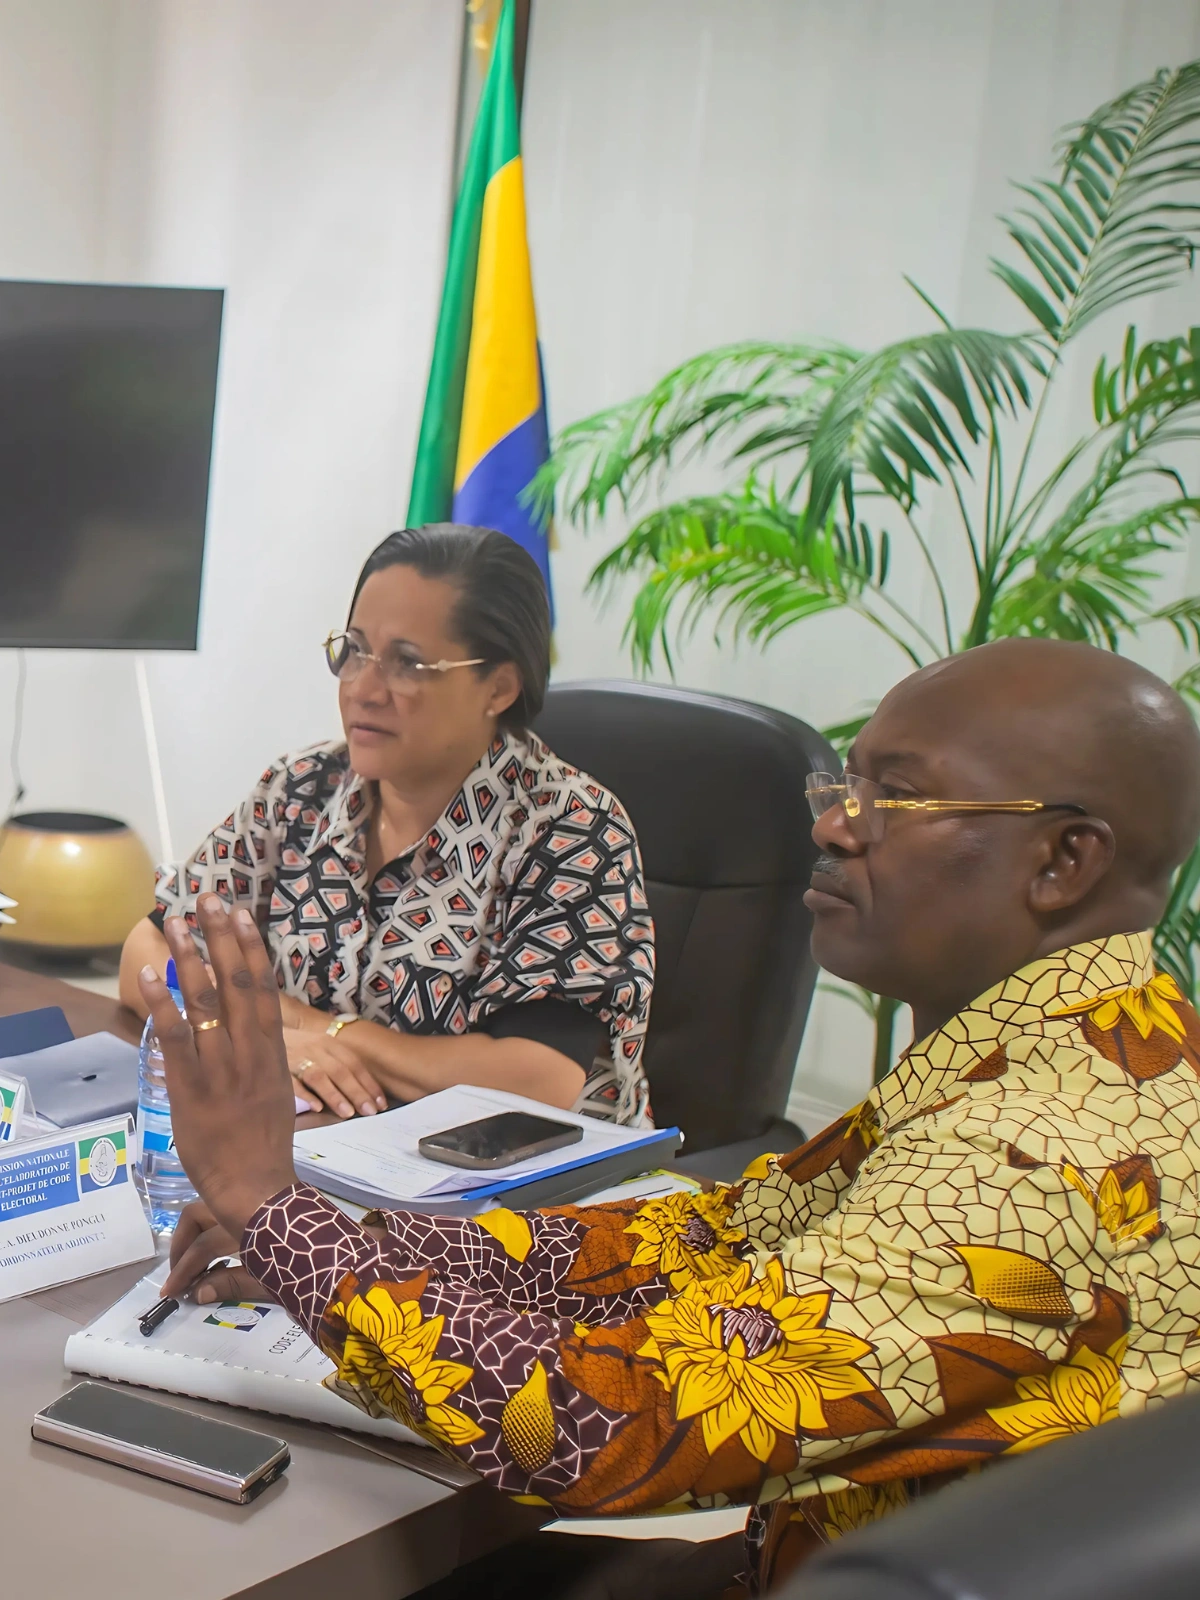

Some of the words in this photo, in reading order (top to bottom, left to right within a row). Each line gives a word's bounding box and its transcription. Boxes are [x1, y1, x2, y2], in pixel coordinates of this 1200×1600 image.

[26, 1149, 70, 1167] NATIONALE
[59, 1161, 70, 1172] DE
[38, 1179, 49, 1189] DE
[50, 1174, 71, 1186] CODE
[1, 1193, 47, 1211] ELECTORAL
[16, 1223, 70, 1245] DIEUDONNE
[72, 1213, 105, 1230] PONGUI
[64, 1234, 100, 1250] ADJOINT
[269, 1337, 296, 1354] CODE
